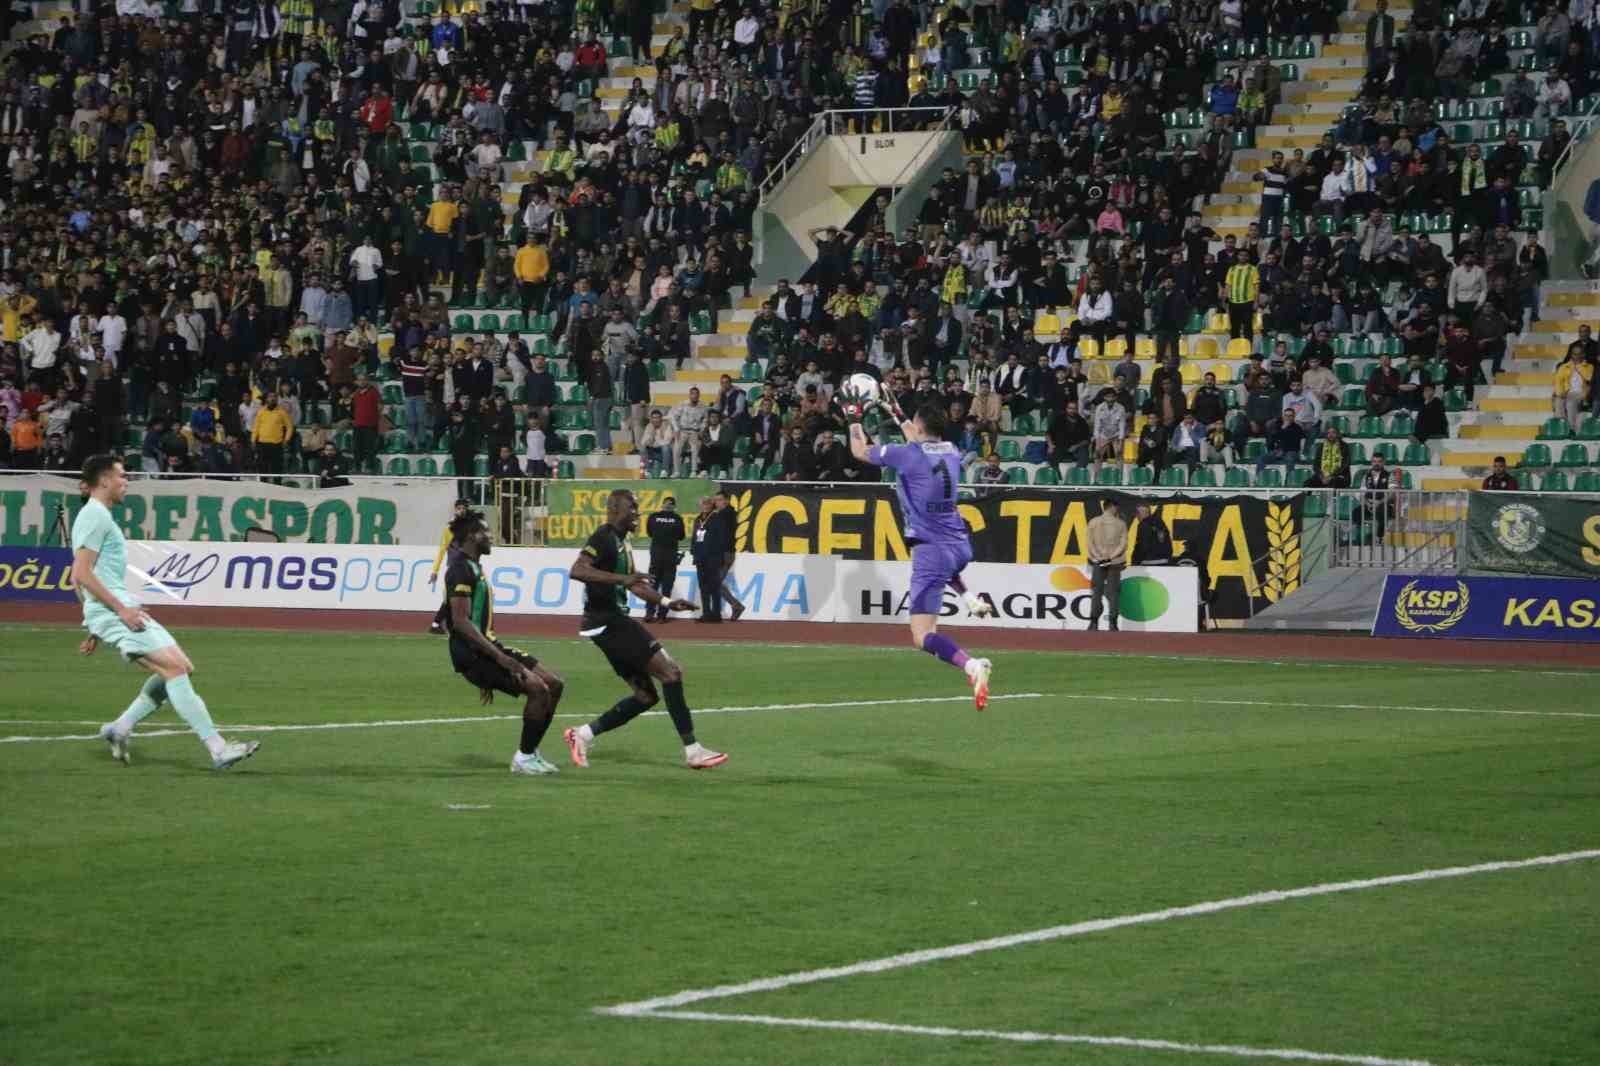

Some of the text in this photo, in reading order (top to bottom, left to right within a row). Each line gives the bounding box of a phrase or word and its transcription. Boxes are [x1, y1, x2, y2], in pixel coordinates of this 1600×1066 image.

[932, 457, 952, 499] 1
[1407, 590, 1458, 609] KSP
[1503, 597, 1600, 628] KAS
